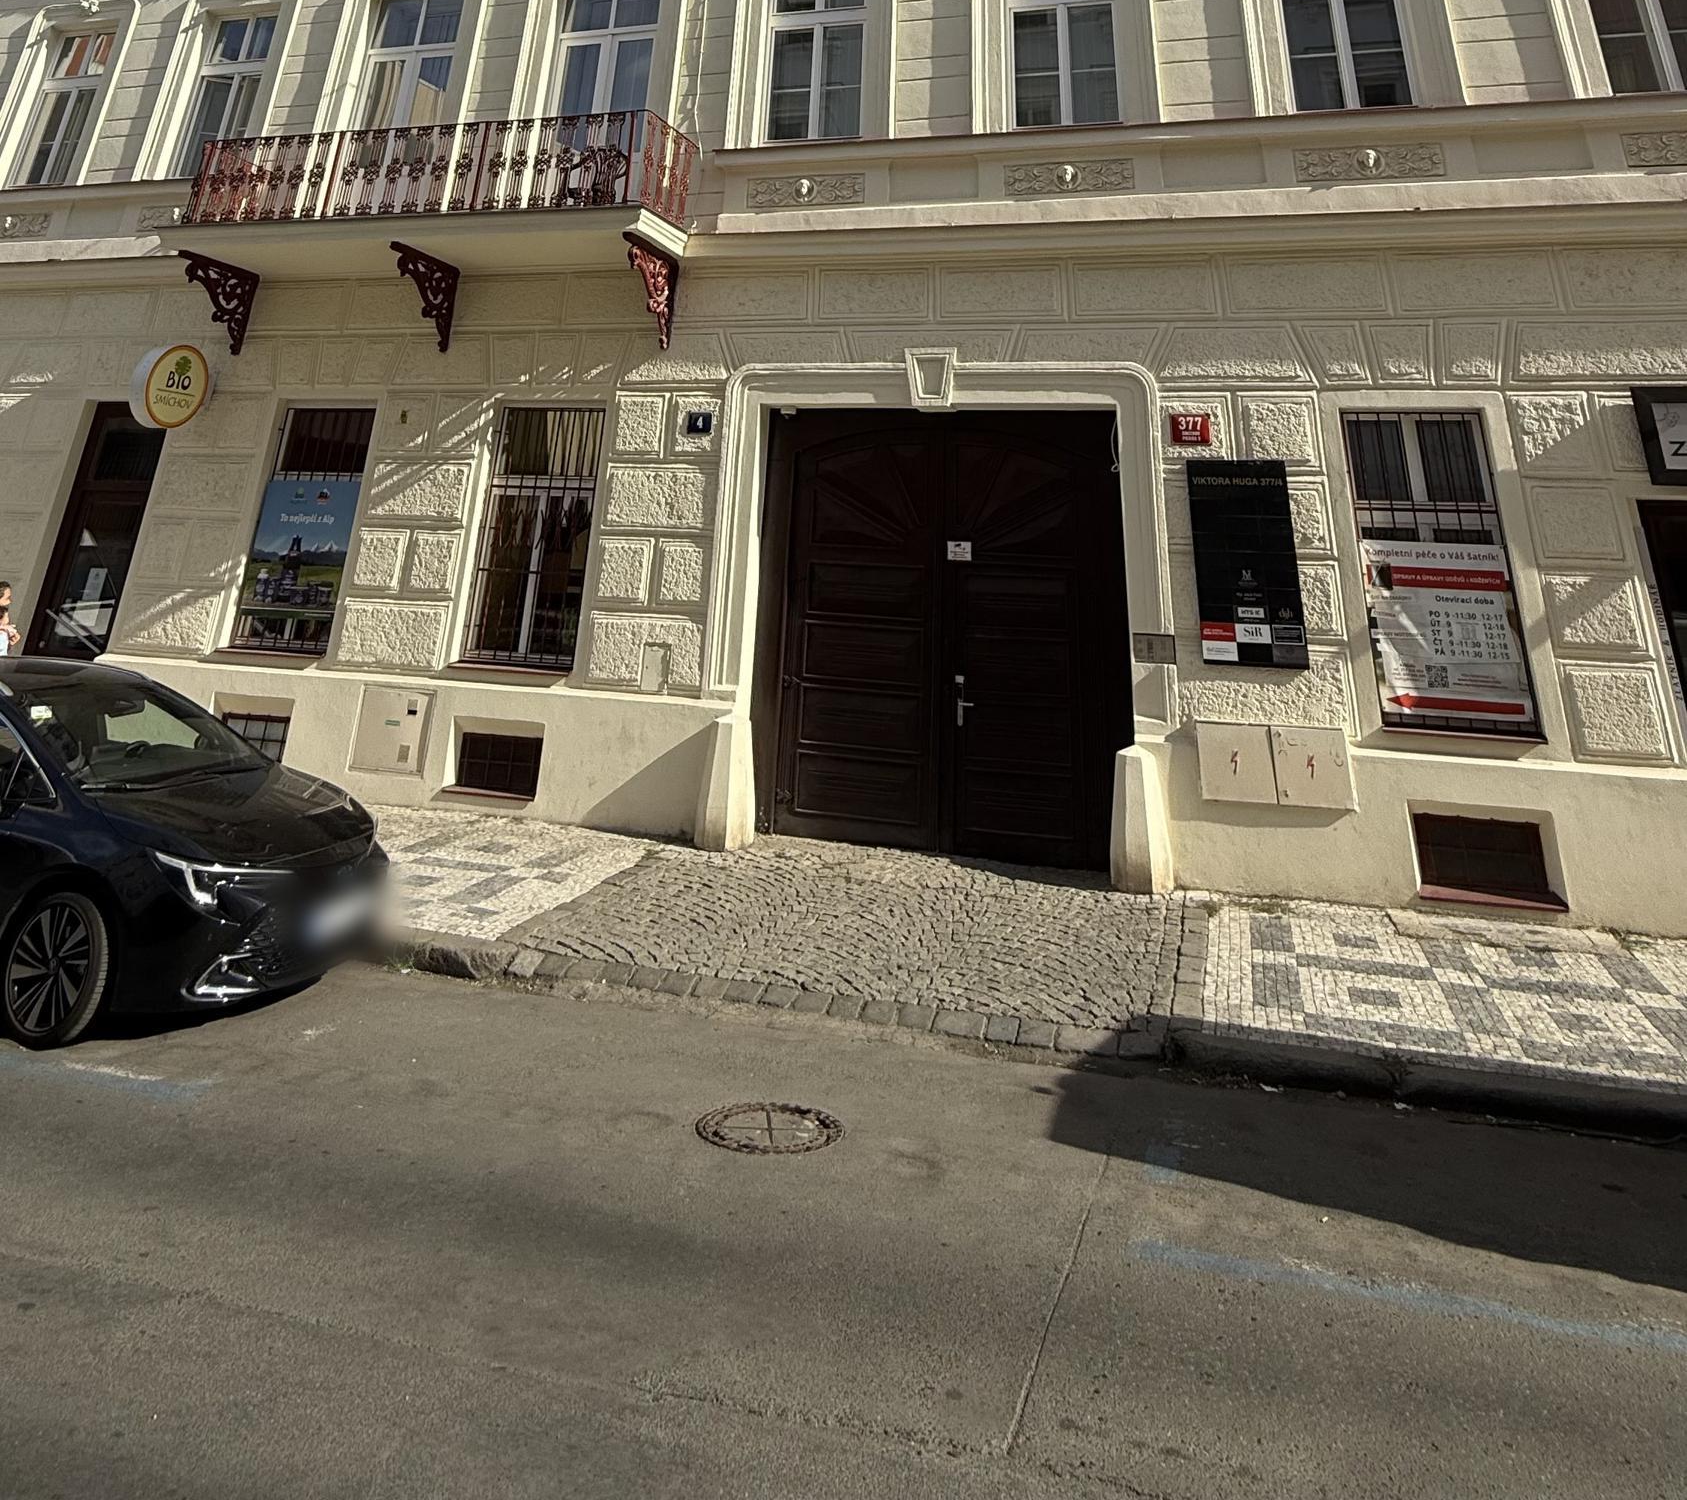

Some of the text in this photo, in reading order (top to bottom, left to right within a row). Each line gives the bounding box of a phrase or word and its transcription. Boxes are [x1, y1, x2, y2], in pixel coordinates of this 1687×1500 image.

[166, 371, 192, 391] BIO
[153, 394, 194, 409] SMÍCHOV
[696, 416, 704, 429] 4
[1178, 416, 1203, 431] 377
[1192, 476, 1283, 486] VIKTORA HUGA 377/4
[1365, 548, 1413, 560] Kompletní
[1448, 550, 1465, 560] Váš
[1474, 595, 1495, 605] doba
[1429, 610, 1441, 618] PO
[1430, 618, 1441, 627] ÚT
[1243, 626, 1263, 638] SiR
[1432, 637, 1442, 646] ČT
